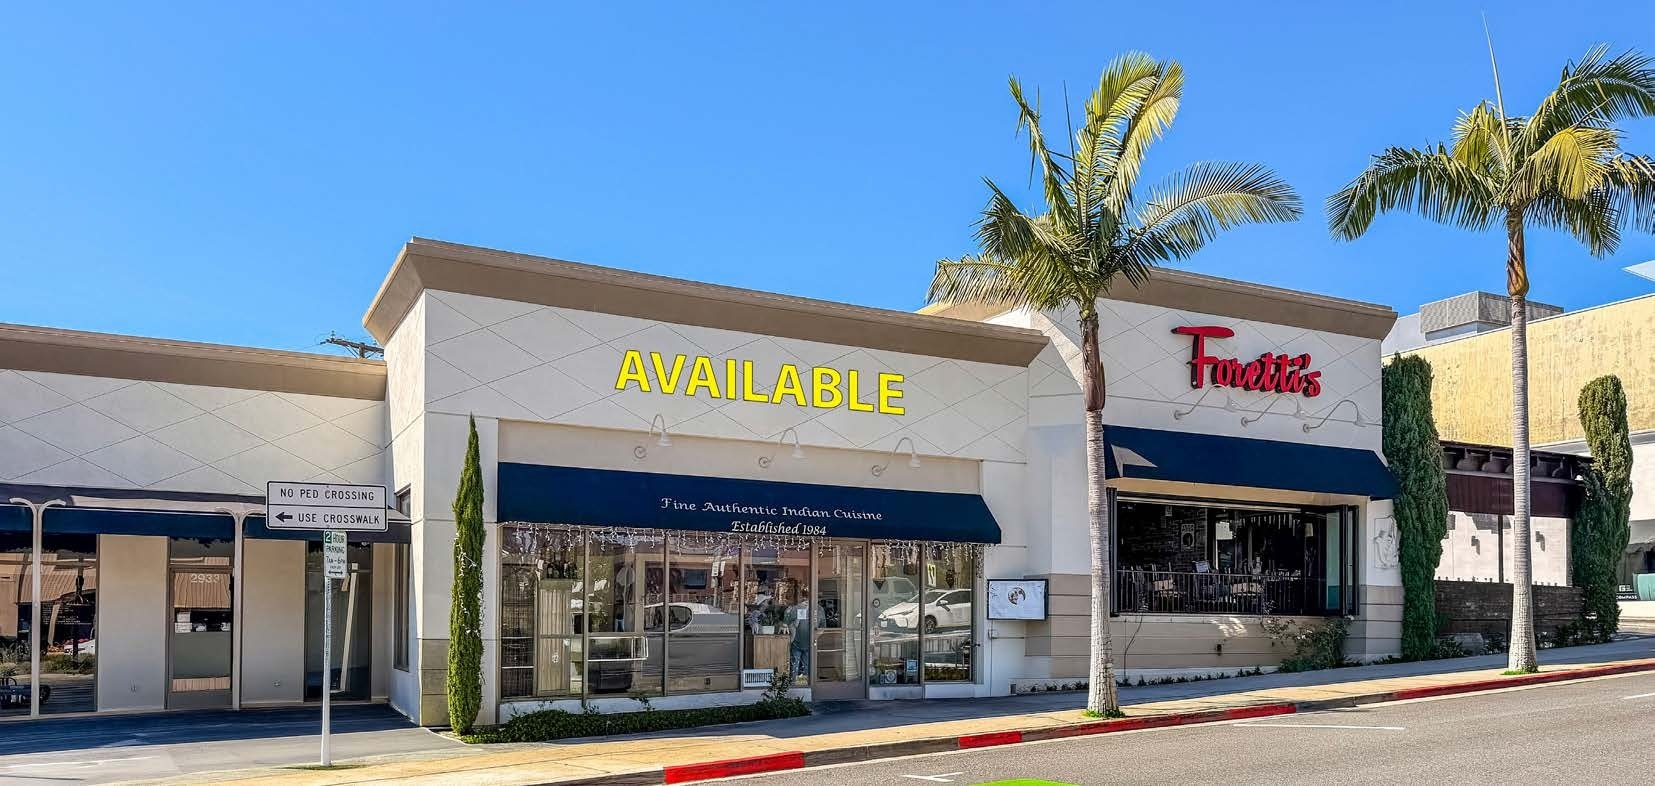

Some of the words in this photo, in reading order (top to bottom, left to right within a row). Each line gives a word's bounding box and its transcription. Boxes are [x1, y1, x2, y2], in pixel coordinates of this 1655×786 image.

[1171, 326, 1321, 397] Foretti's
[280, 488, 294, 498] NO
[300, 489, 319, 499] PED
[324, 490, 375, 501] CROSSING
[661, 498, 697, 511] Fine
[702, 502, 778, 515] Authentic
[782, 507, 831, 518] Indian
[833, 509, 883, 520] Cuisine
[298, 513, 317, 523] USE
[323, 514, 380, 524] CROSSWALK
[731, 520, 802, 534] Established
[802, 524, 827, 535] 1984
[325, 531, 332, 542] 2
[190, 573, 220, 583] 2933
